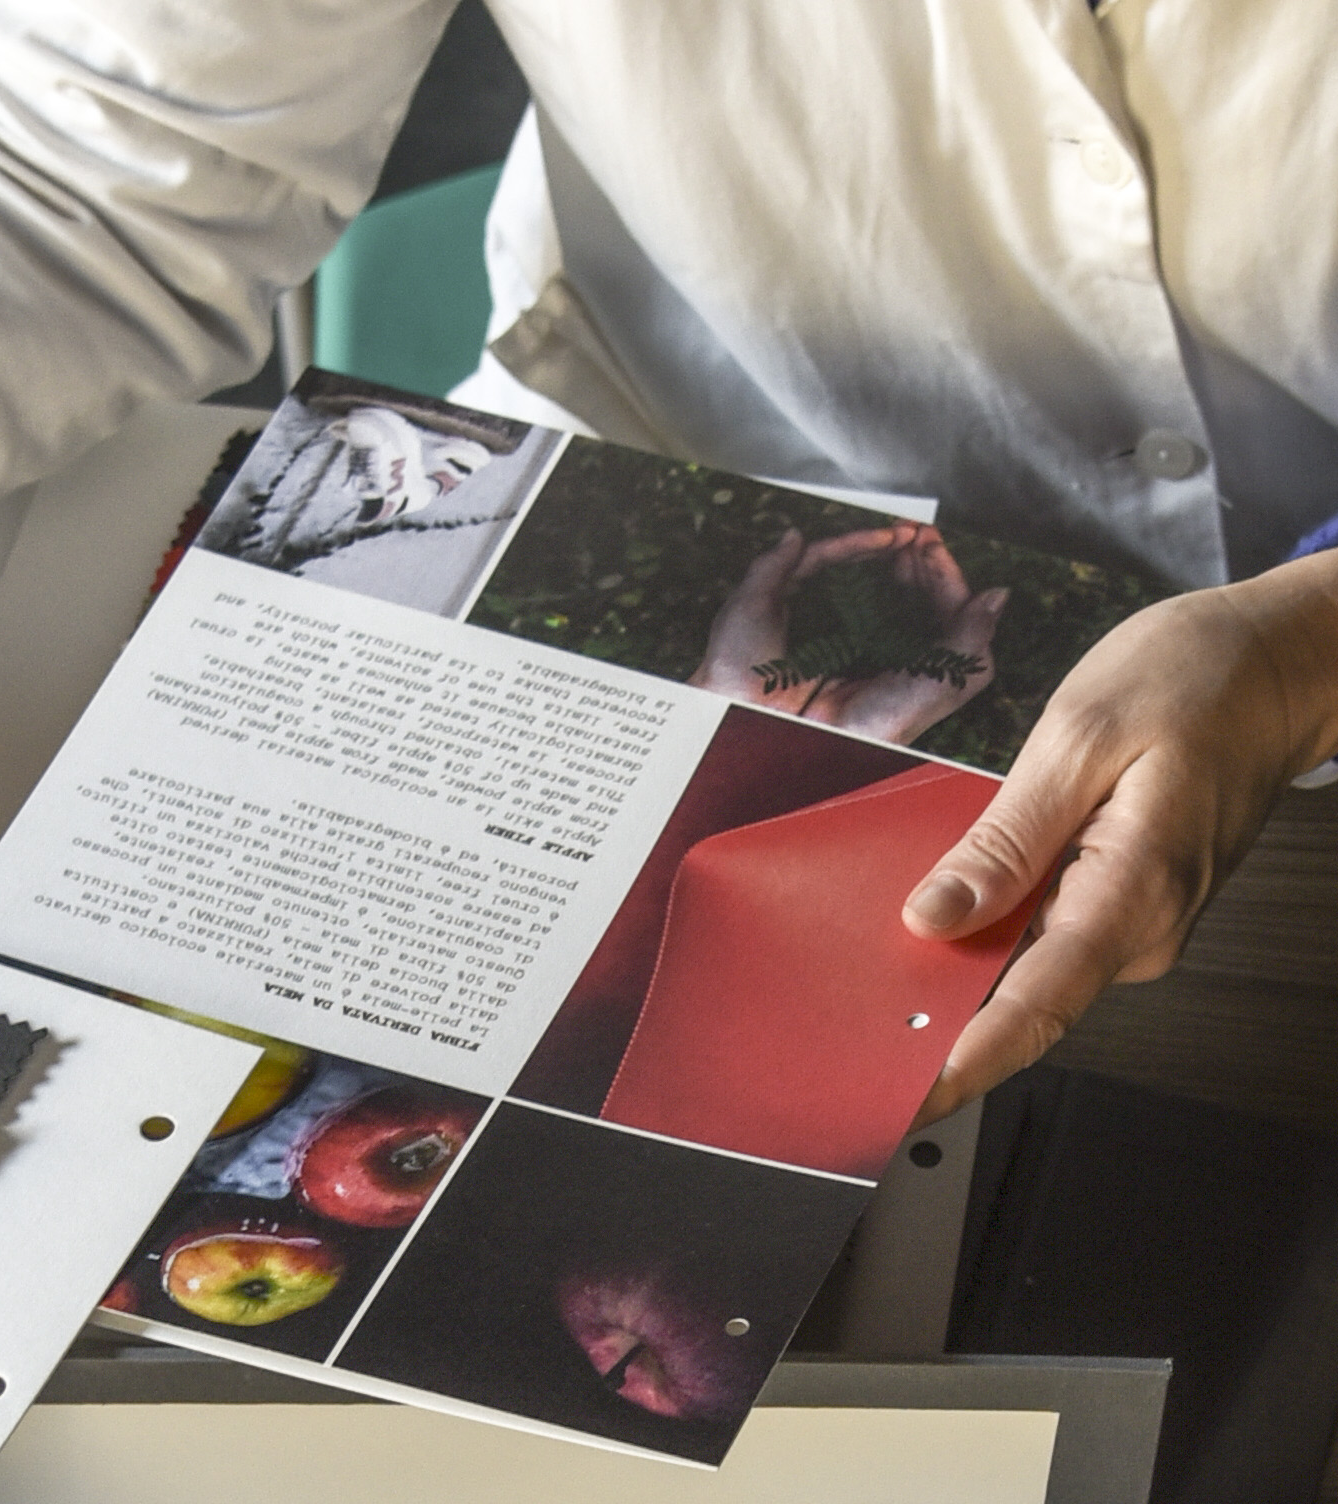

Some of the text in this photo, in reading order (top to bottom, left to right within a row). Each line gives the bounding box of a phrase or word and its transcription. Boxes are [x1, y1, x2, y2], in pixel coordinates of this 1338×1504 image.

[146, 688, 610, 833] from apple powder, made from apple peel (PURRINA)
[179, 716, 603, 848] Apple skin is an ecological material derived
[484, 824, 595, 863] APPLE FIBER
[33, 895, 112, 925] derivato
[118, 920, 207, 954] ecologico
[81, 891, 499, 1023] dalla polvere di mela, realizzato a partire
[215, 950, 305, 983] materiale
[312, 978, 332, 991] un
[264, 982, 481, 1052] FIBRA DERIVATA DA MELA
[360, 992, 463, 1028] pelle-mela
[469, 1024, 490, 1038] La
